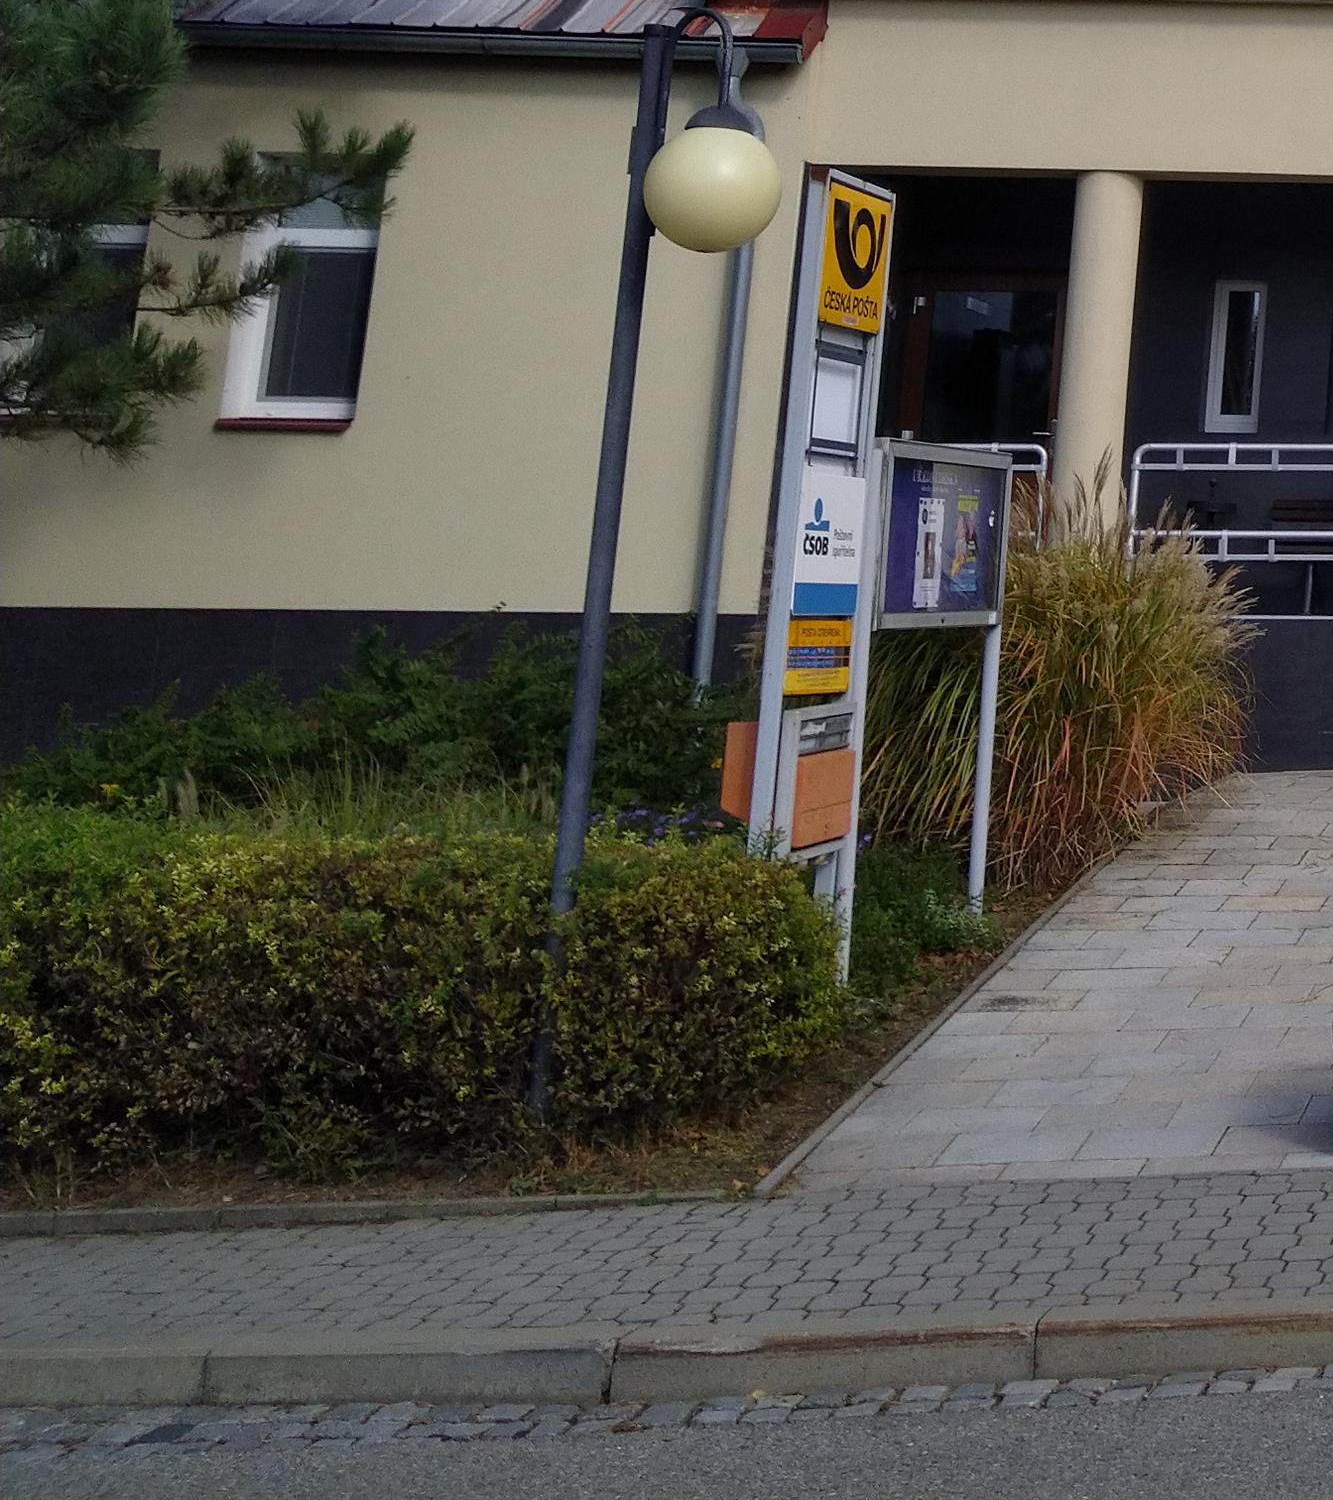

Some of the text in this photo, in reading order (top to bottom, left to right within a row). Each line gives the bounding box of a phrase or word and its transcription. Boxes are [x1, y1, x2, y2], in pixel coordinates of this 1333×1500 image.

[824, 285, 878, 319] ČESKÁ POŠTA
[803, 532, 829, 556] ČSOB
